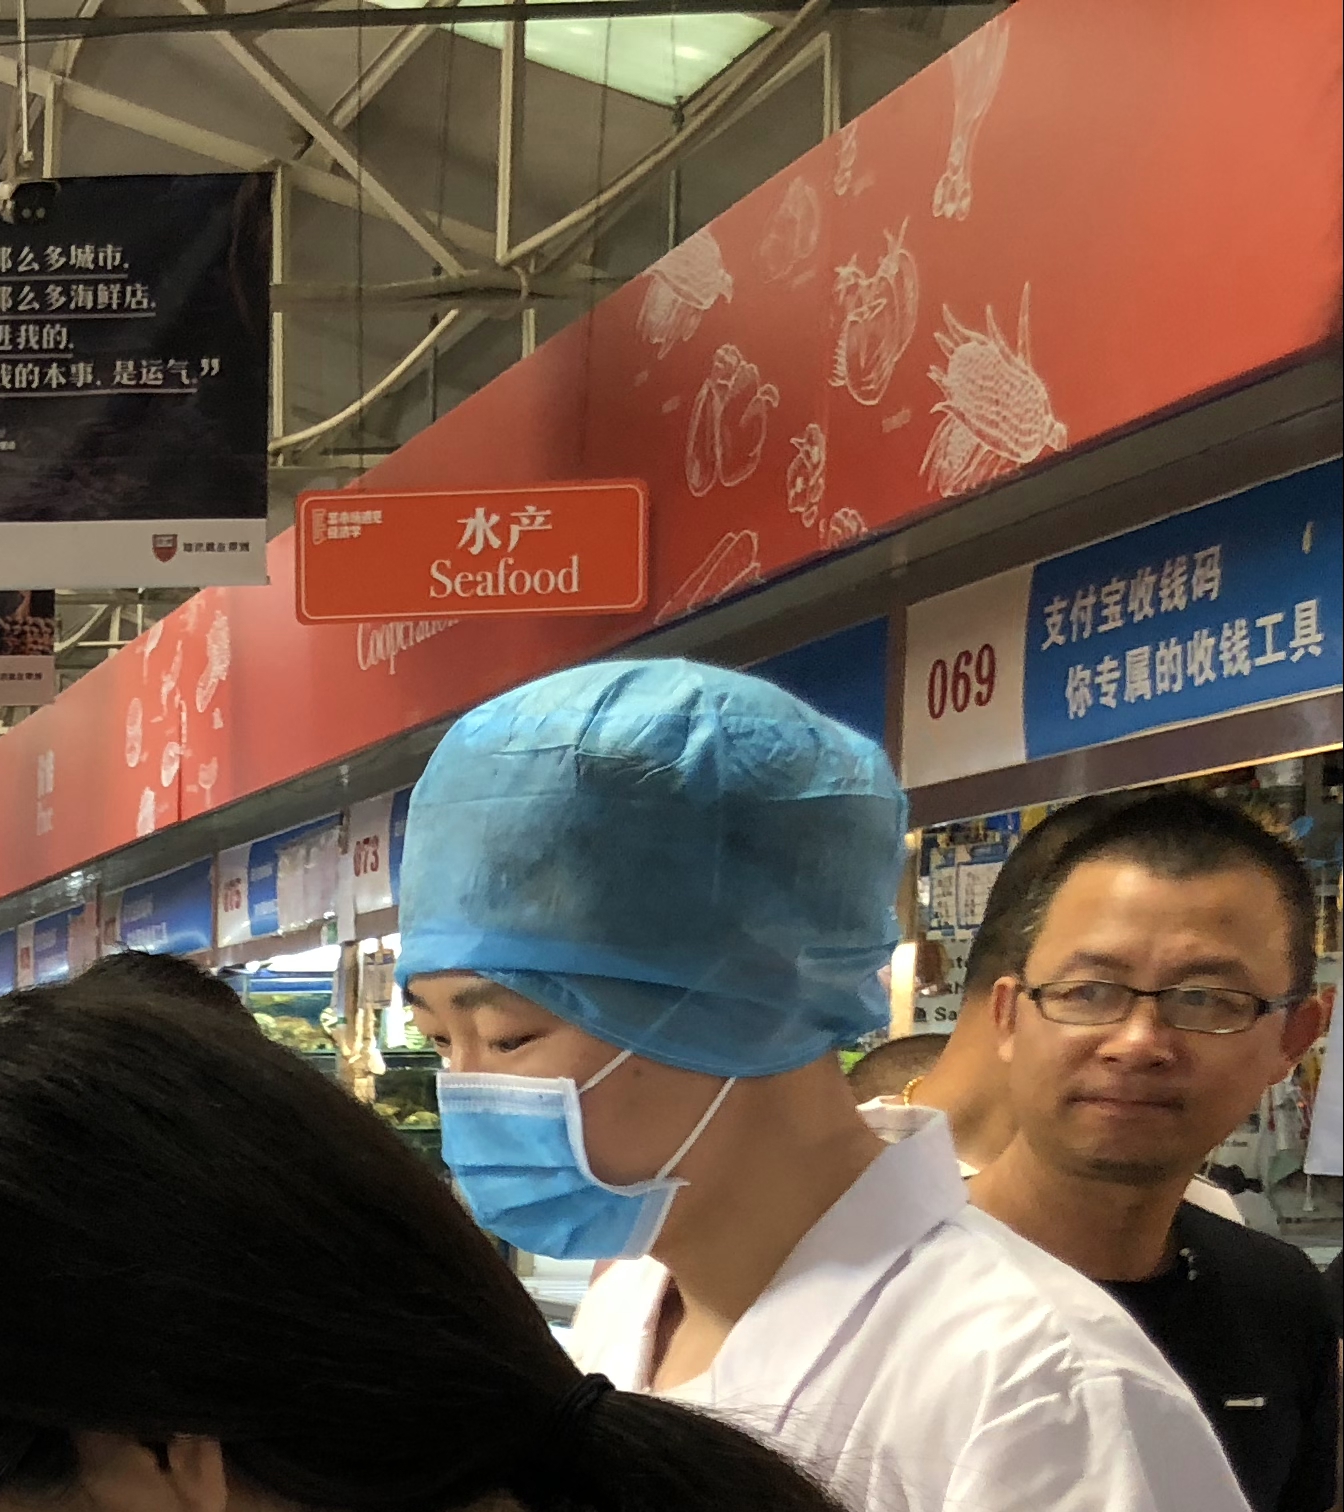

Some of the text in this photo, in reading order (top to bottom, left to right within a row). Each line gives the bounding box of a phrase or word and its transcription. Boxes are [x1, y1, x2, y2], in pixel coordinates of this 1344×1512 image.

[456, 505, 553, 555] 水产
[429, 555, 580, 599] Seafood
[1041, 544, 1223, 651] 支付宝收钱码
[927, 643, 997, 720] 069
[1064, 598, 1325, 720] 你专属的收钱工具
